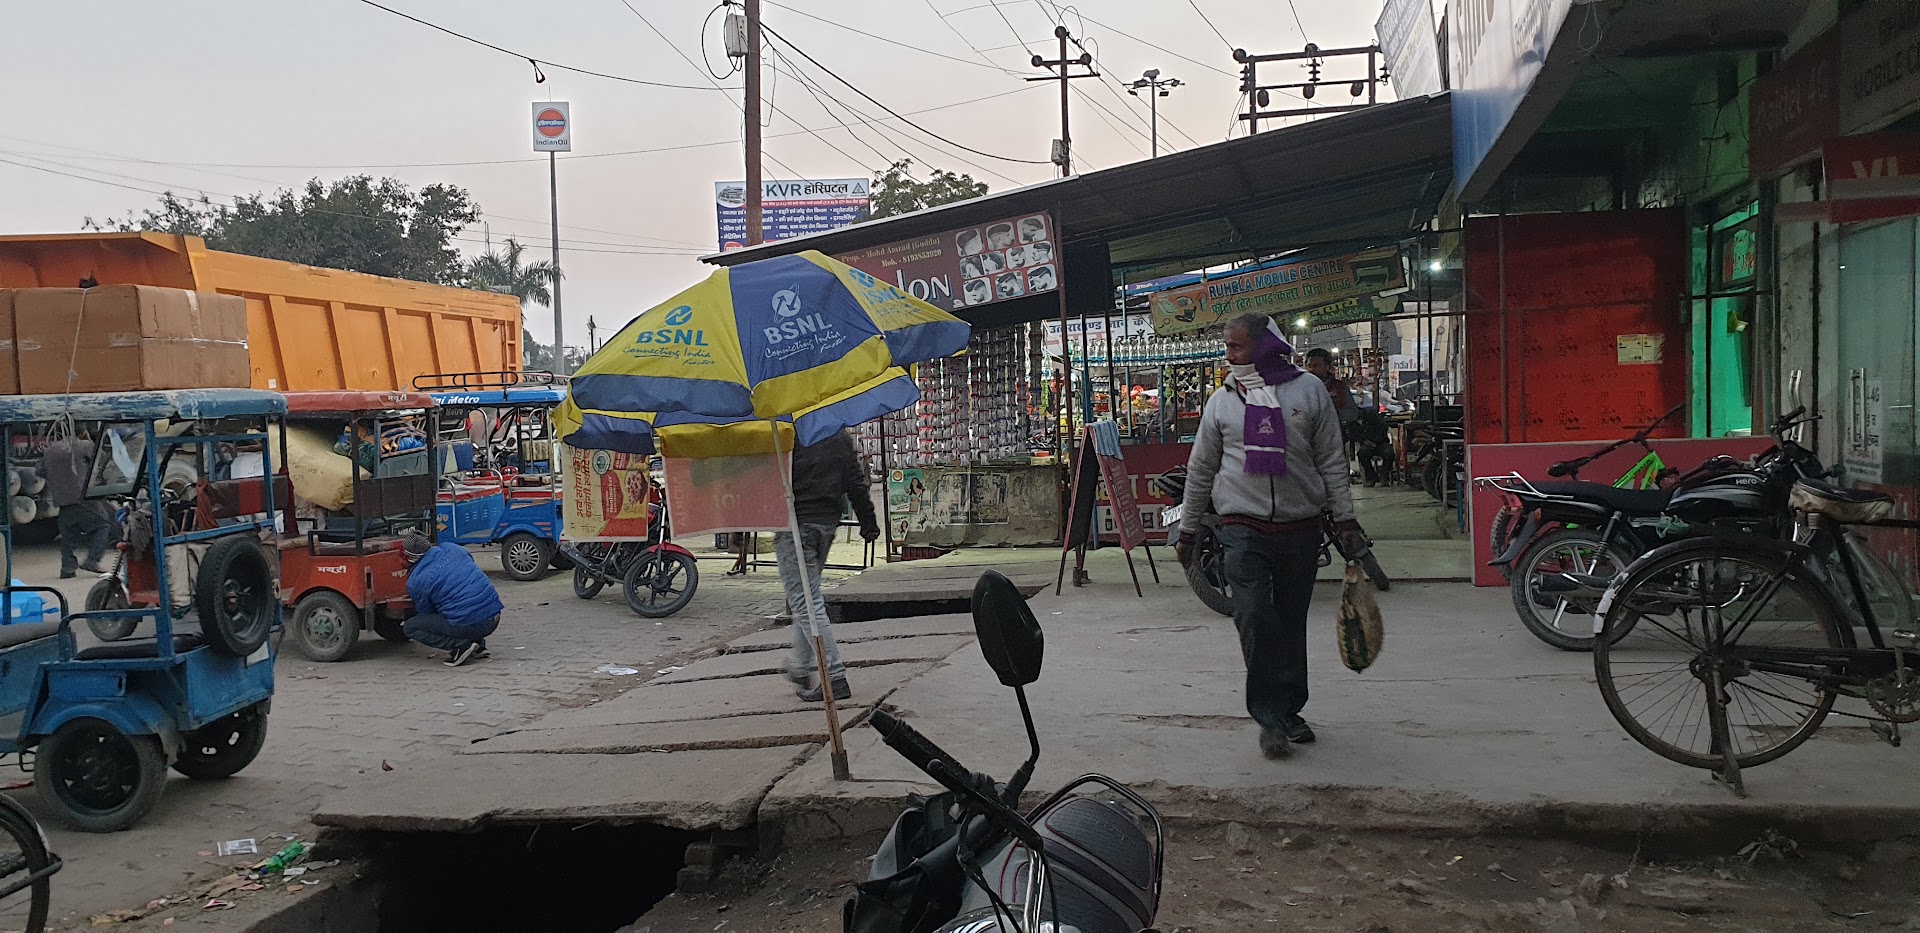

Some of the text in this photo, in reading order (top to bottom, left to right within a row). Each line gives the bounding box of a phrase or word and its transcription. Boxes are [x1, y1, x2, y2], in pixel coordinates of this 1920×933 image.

[766, 183, 802, 198] KVR
[1208, 259, 1345, 299] RUHELA MOBILE CENTRE
[862, 286, 906, 304] SNL
[763, 312, 832, 344] BSNL
[636, 329, 709, 346] BSNL
[815, 331, 841, 344] India
[623, 346, 711, 360] Connecting India
[388, 394, 407, 403] मयूरी
[448, 396, 479, 404] Metro
[318, 565, 347, 574] मयूरी
[392, 569, 408, 578] मयूर
